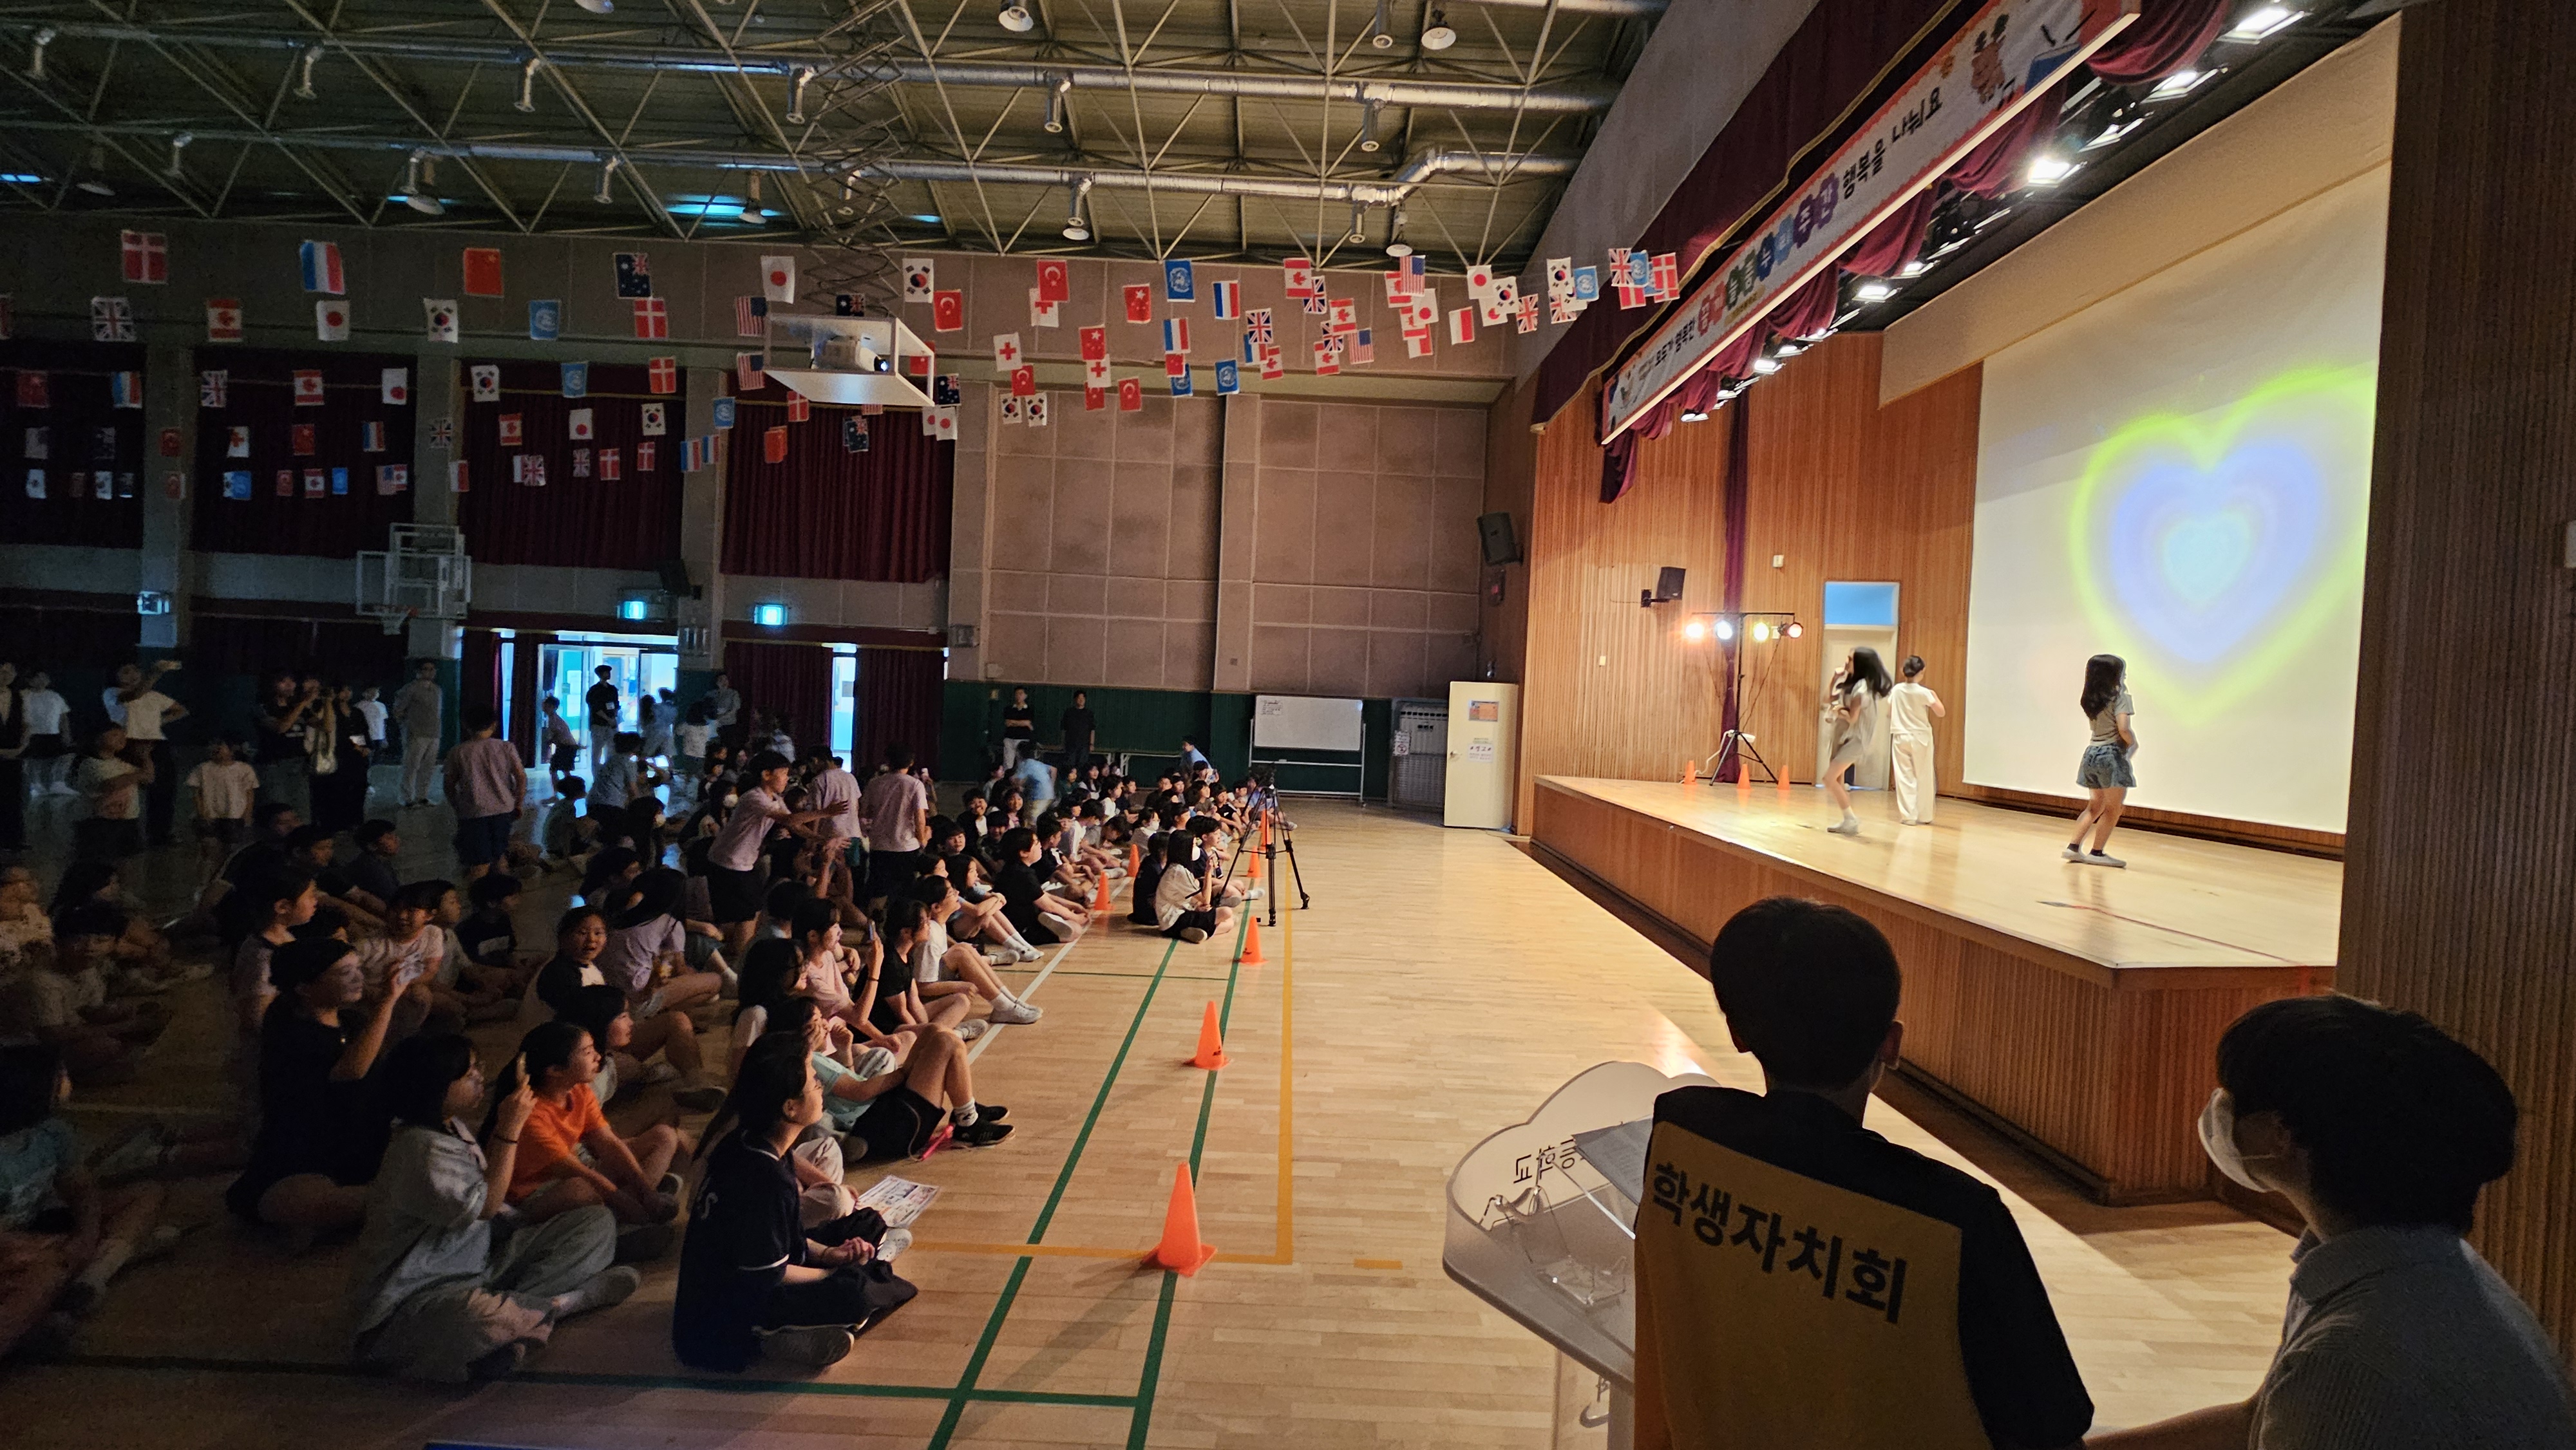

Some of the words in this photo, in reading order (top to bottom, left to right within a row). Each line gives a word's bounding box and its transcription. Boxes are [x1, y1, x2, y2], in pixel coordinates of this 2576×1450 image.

[1676, 317, 1696, 353] 행복한
[1843, 138, 1886, 200] 행복을
[1891, 86, 1944, 144] 나눠요
[1652, 1162, 1908, 1324] 학생자치회
